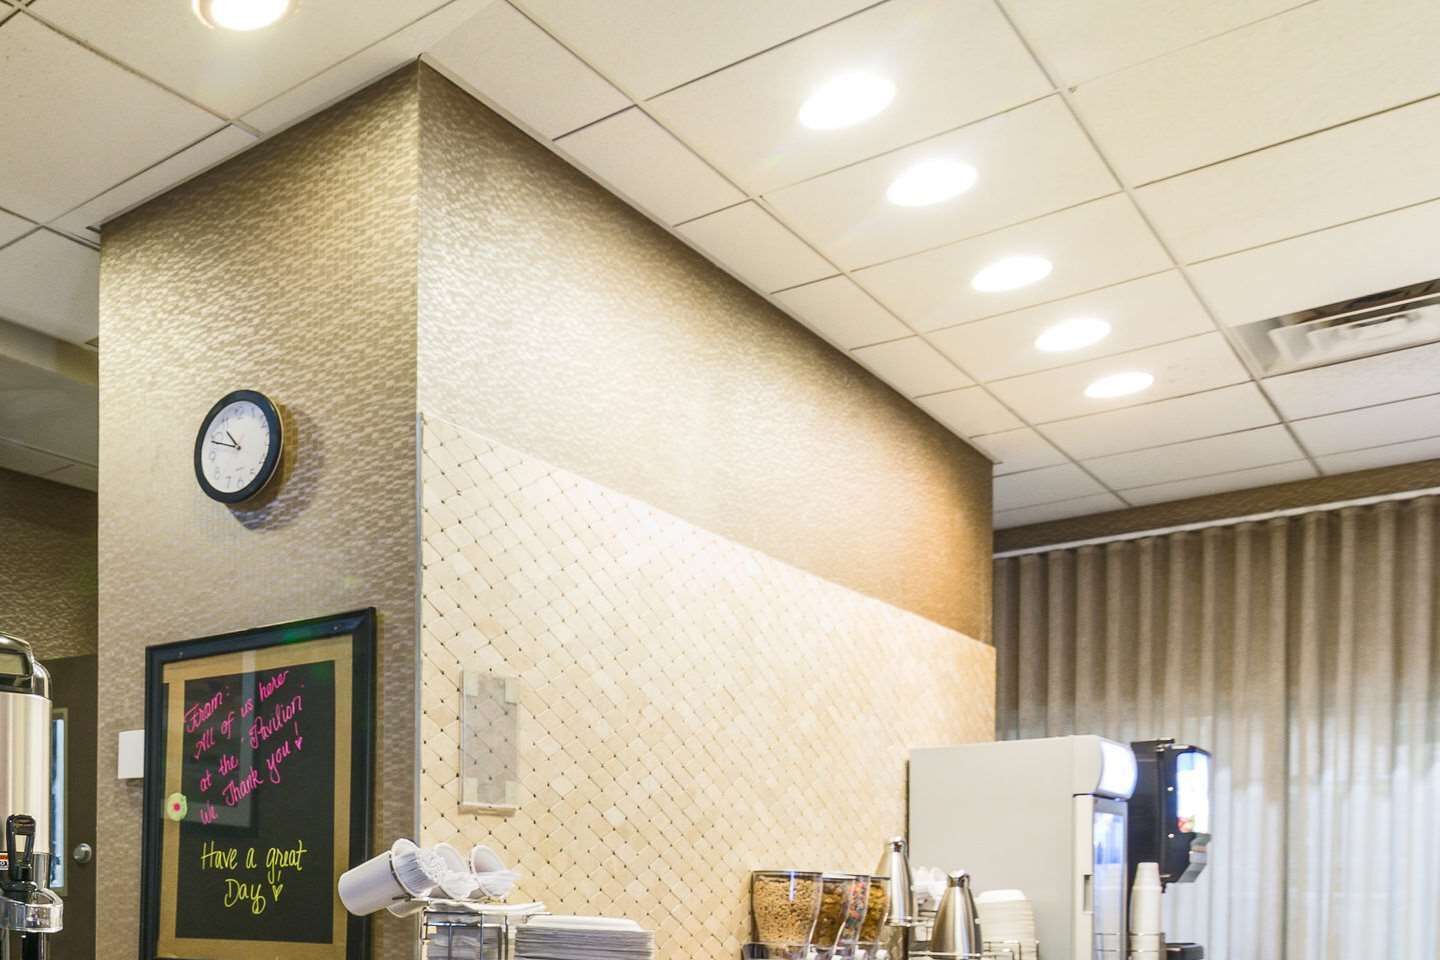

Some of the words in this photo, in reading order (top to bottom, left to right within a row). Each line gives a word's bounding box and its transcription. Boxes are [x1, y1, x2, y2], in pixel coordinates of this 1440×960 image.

[194, 728, 216, 760] All
[220, 711, 235, 740] of
[241, 698, 254, 718] us
[259, 670, 289, 702] here
[200, 769, 212, 792] at
[218, 754, 239, 776] the
[248, 695, 303, 750] Pavilion
[222, 765, 264, 807] Thank
[200, 840, 238, 870] Have
[245, 847, 258, 869] a
[266, 839, 308, 885] great
